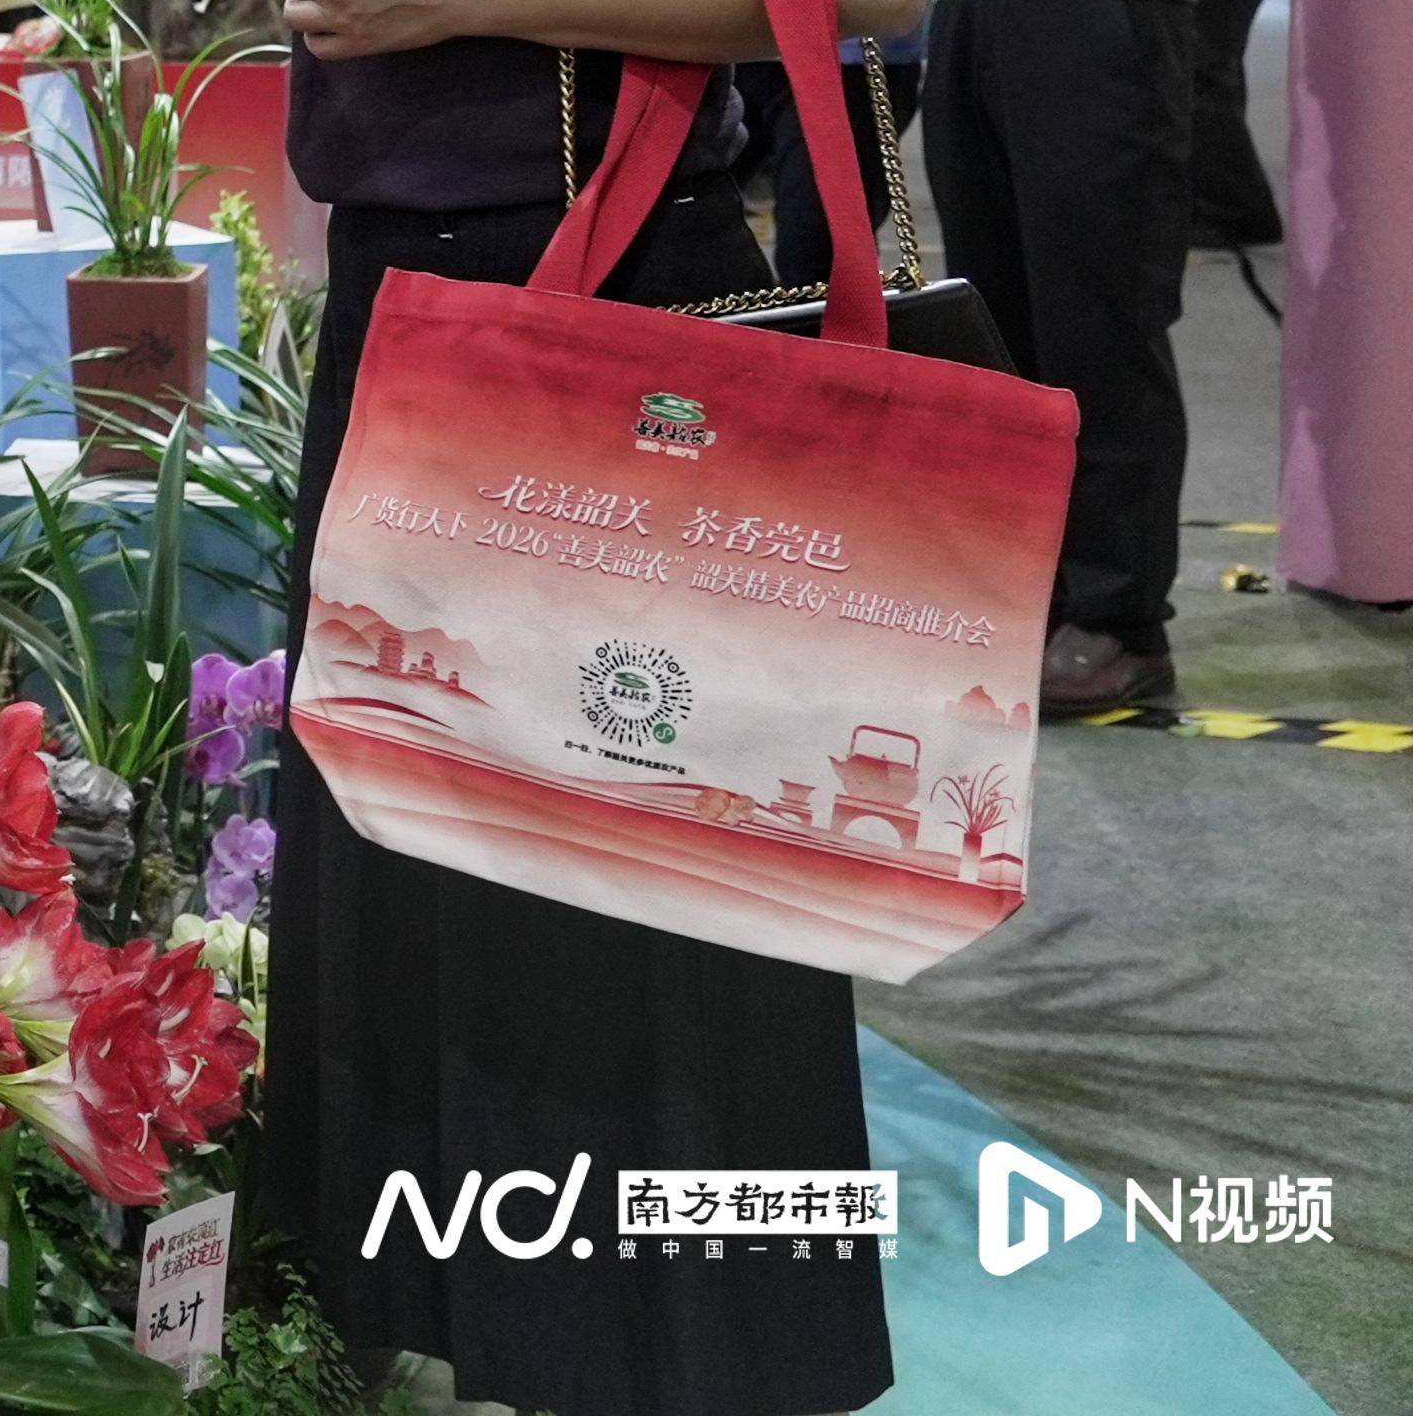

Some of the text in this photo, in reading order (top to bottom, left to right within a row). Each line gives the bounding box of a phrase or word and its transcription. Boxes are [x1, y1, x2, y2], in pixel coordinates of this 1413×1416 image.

[478, 474, 851, 572] 花漾韶关 茶香莞邑
[347, 493, 471, 539] 广货行天下
[689, 559, 997, 648] 韶关精美农产品招商推介会
[160, 1239, 225, 1282] 生活注定红
[150, 1290, 205, 1342] 设计
